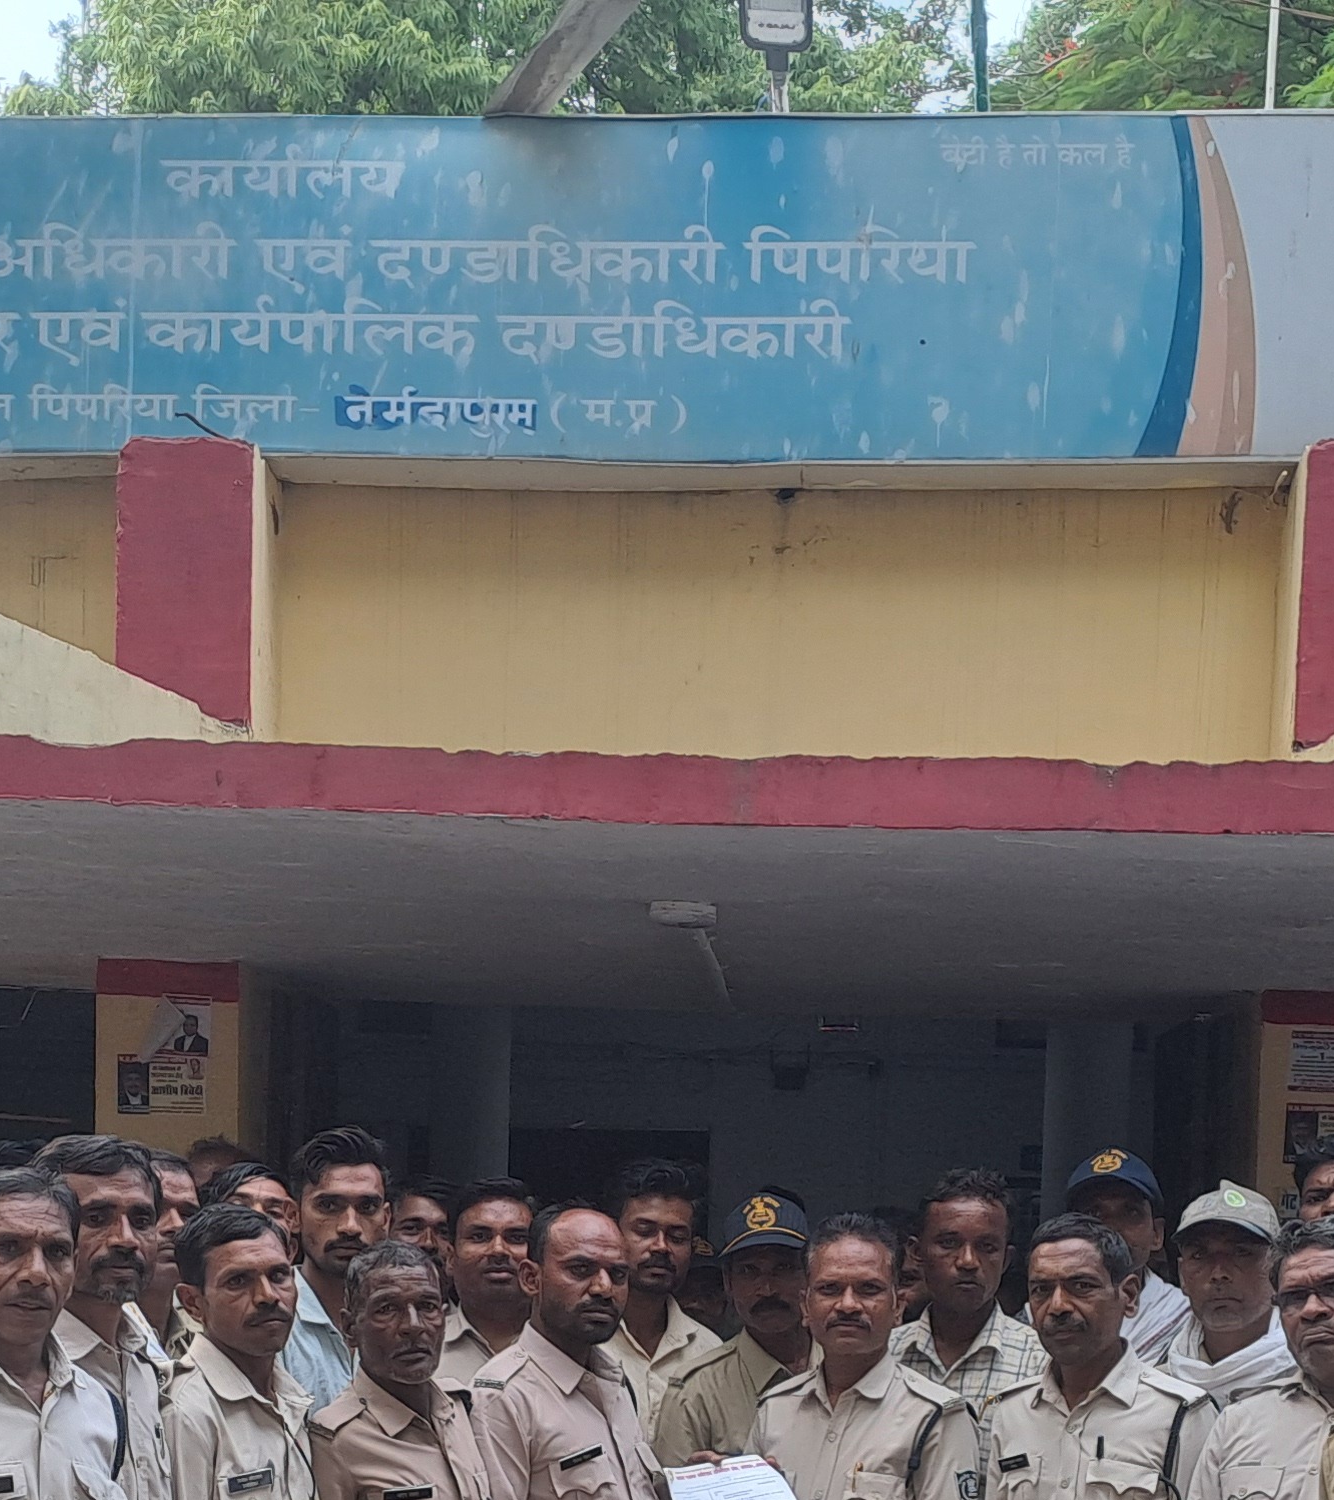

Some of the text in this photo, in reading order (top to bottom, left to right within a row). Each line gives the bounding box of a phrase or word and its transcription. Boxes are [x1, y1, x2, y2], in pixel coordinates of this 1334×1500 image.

[160, 144, 405, 199] कार्यालय
[940, 133, 1135, 169] बेटी है तो कल है
[254, 224, 353, 294] एवं
[369, 224, 726, 288] दण्डाधिकारी
[743, 224, 977, 285] पिपरिया
[30, 301, 128, 366] एवं
[140, 295, 480, 357] कार्यपालिक
[496, 299, 853, 364] दण्डाधिकारी
[27, 383, 180, 422] पिपरिया
